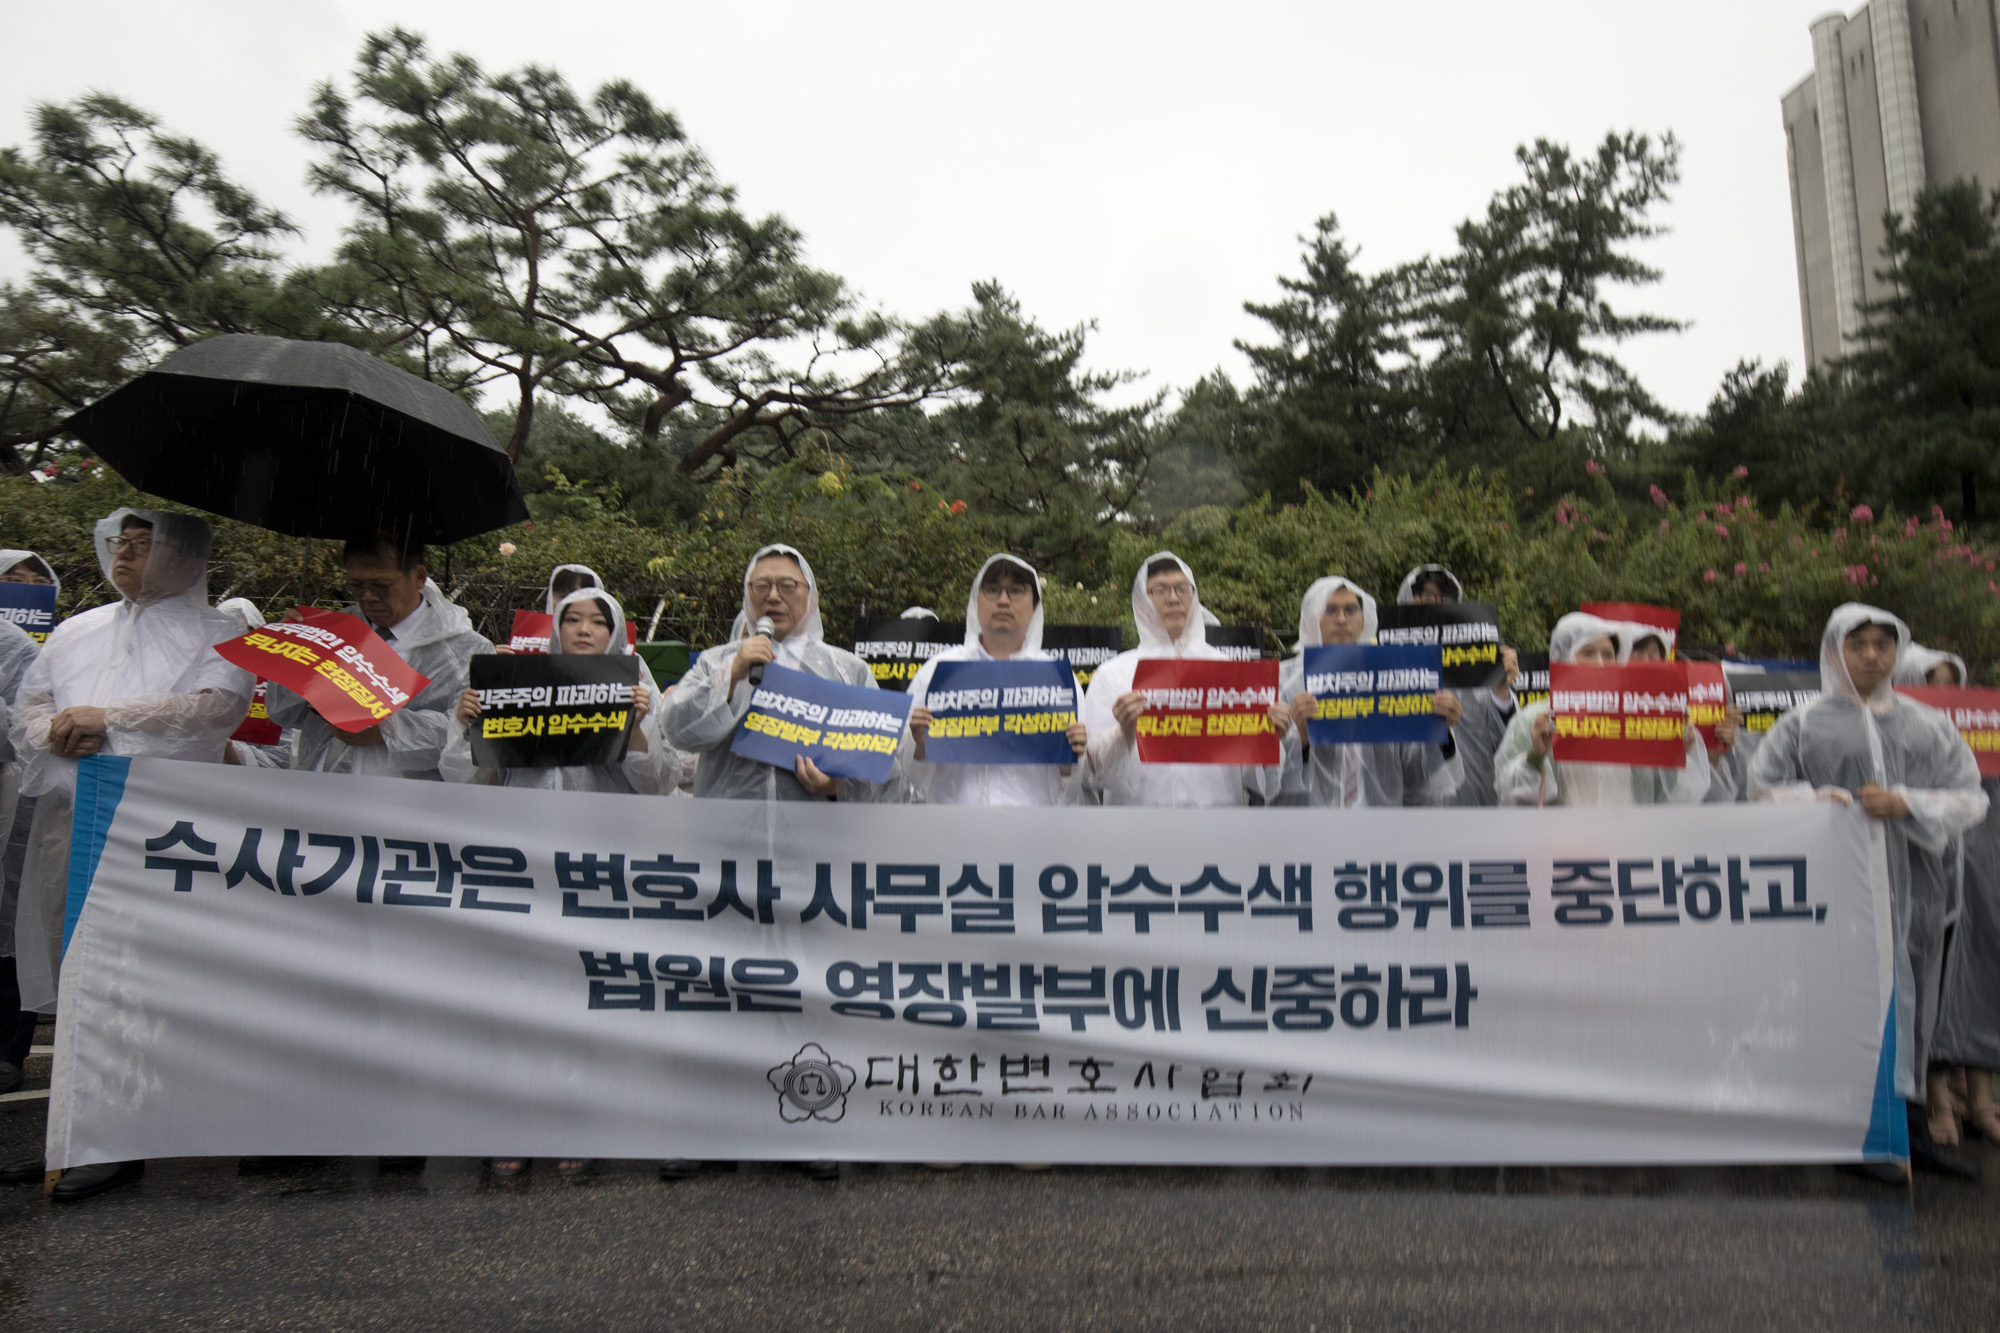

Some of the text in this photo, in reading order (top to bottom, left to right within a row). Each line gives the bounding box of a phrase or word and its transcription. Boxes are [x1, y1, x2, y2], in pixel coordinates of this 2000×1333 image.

[1441, 622, 1499, 642] 파괴하는
[854, 641, 913, 659] 민주주의
[243, 633, 392, 720] 무너지는 헌정질서
[334, 645, 410, 706] 압수수색
[1306, 668, 1440, 695] 법치주의 파괴하는
[477, 682, 633, 710] 민주주의 파괴하는
[927, 685, 1074, 713] 법치주의 파괴하는
[1206, 686, 1276, 710] 압수수색
[1552, 690, 1620, 713] 법무법인
[1622, 690, 1688, 715] 압수수색
[483, 710, 628, 738] 변호사 압수수색
[751, 689, 903, 733] 법치주의 파괴하는
[744, 712, 898, 756] 영장발부 각성하라
[928, 715, 1000, 738] 영장발부
[1136, 714, 1203, 737] 무너지는
[1555, 715, 1621, 738] 무너지는
[145, 821, 1828, 935] 수사기관은 변호사 사무실 압수수색 행위를 중단하고,
[579, 951, 1479, 1033] 법원은 영장발부에 신중하라
[879, 1101, 1303, 1122] KOREAN BAR ASSOCIATION
